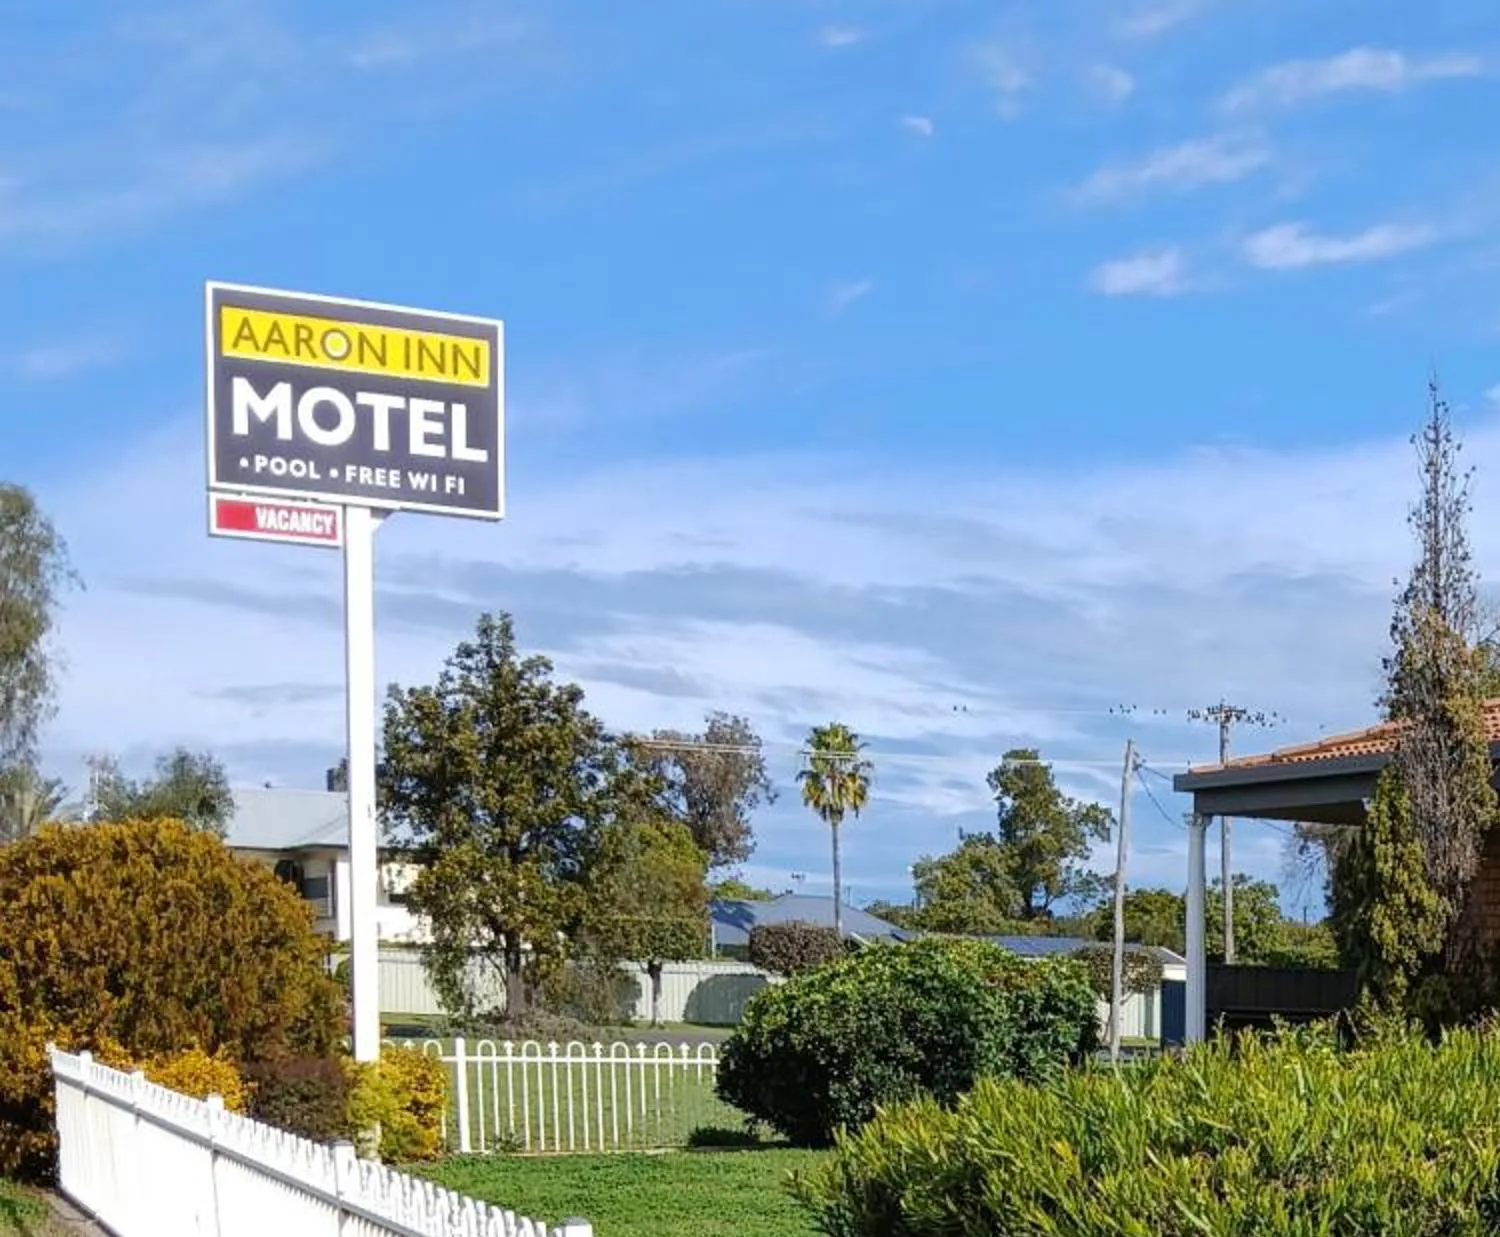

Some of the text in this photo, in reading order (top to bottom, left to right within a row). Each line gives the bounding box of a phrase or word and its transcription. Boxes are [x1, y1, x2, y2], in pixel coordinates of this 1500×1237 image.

[232, 316, 481, 379] AARON INN
[231, 376, 489, 463] MOTEL
[254, 454, 465, 495] POOL FREE WI FI
[255, 506, 335, 536] VACANCY
